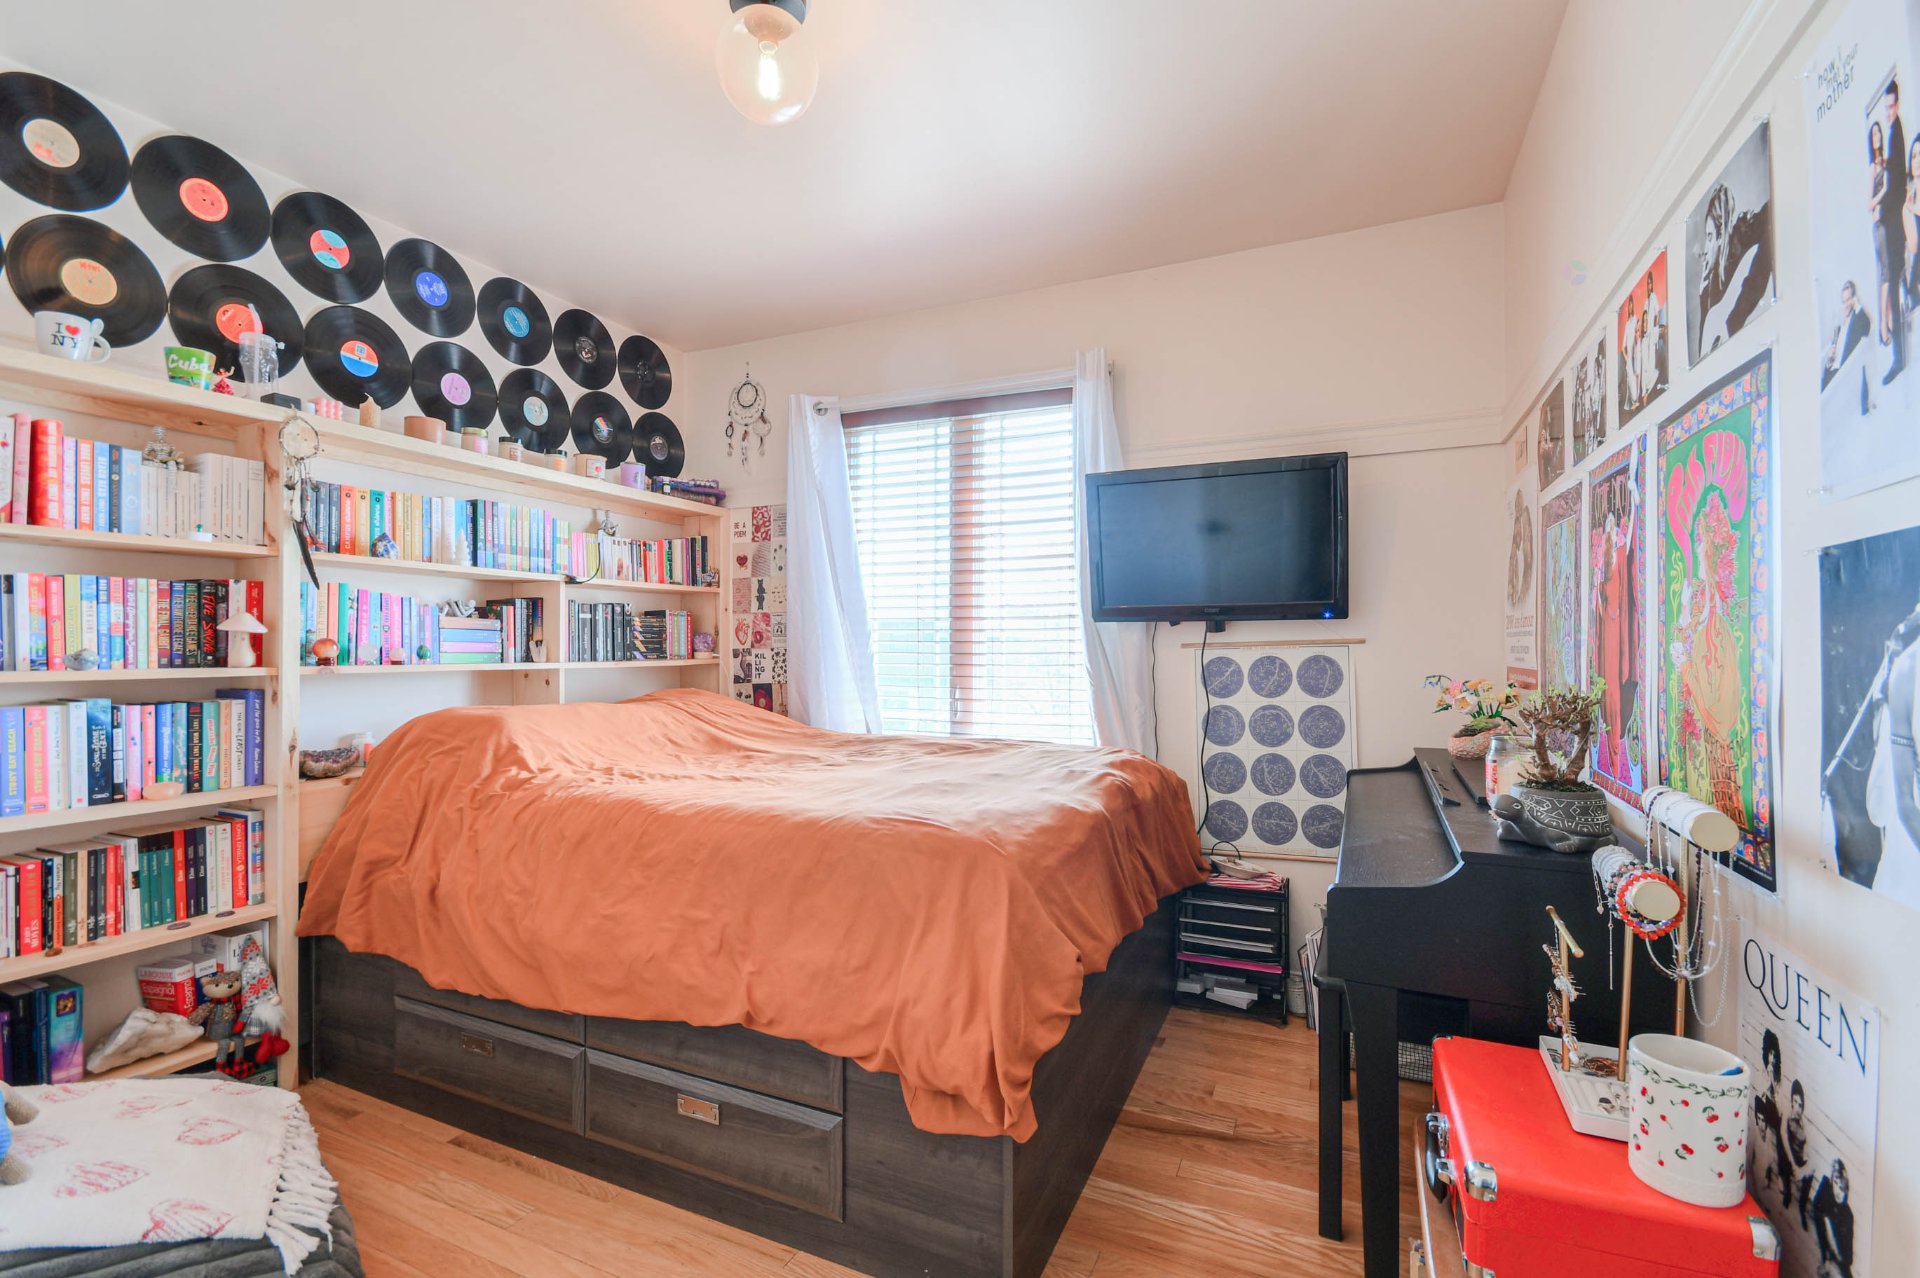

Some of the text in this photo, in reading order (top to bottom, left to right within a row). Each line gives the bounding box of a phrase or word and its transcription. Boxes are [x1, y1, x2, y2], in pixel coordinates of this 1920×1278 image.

[1843, 43, 1858, 71] your
[1817, 61, 1836, 88] how
[1816, 65, 1854, 122] mother
[50, 334, 80, 348] NY
[56, 322, 64, 334] I
[168, 354, 211, 373] Cuba
[734, 530, 746, 538] POEM
[158, 598, 169, 649] THE FINAL GAMBIT
[172, 594, 183, 654] THE HAWTHORNE LEGACY
[186, 593, 198, 655] THE INHERITANCE GAMES
[202, 595, 216, 654] FIVE SURVIVE
[754, 652, 766, 660] KIL
[55, 882, 62, 890] Ng
[31, 920, 39, 948] MOYES
[142, 982, 174, 996] Espagnol
[184, 978, 193, 1009] Espagnol
[1744, 938, 1870, 1080] QUEEN
